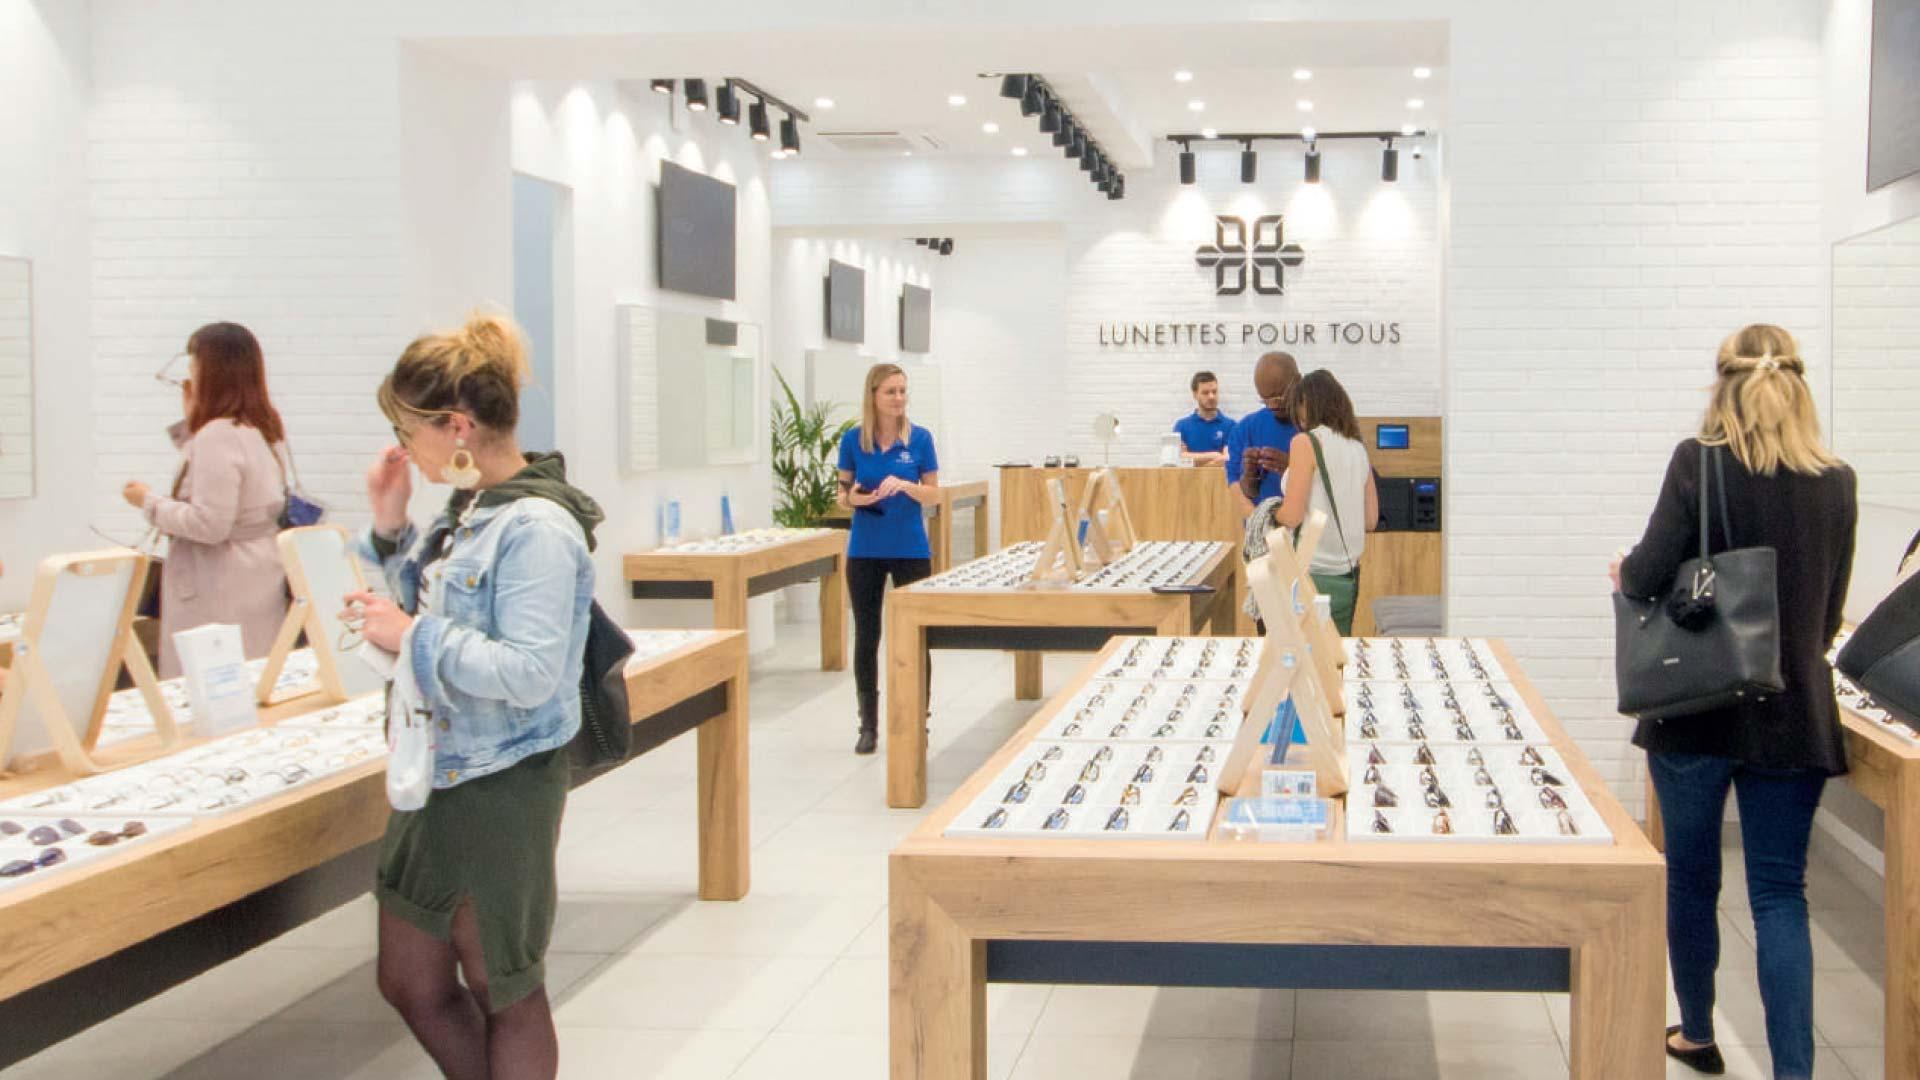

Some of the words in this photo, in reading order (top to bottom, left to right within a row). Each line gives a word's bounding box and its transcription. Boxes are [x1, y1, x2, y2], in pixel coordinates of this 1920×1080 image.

[1099, 323, 1226, 345] LUNETTES
[1242, 323, 1316, 345] POUR
[1329, 323, 1401, 345] TOUS
